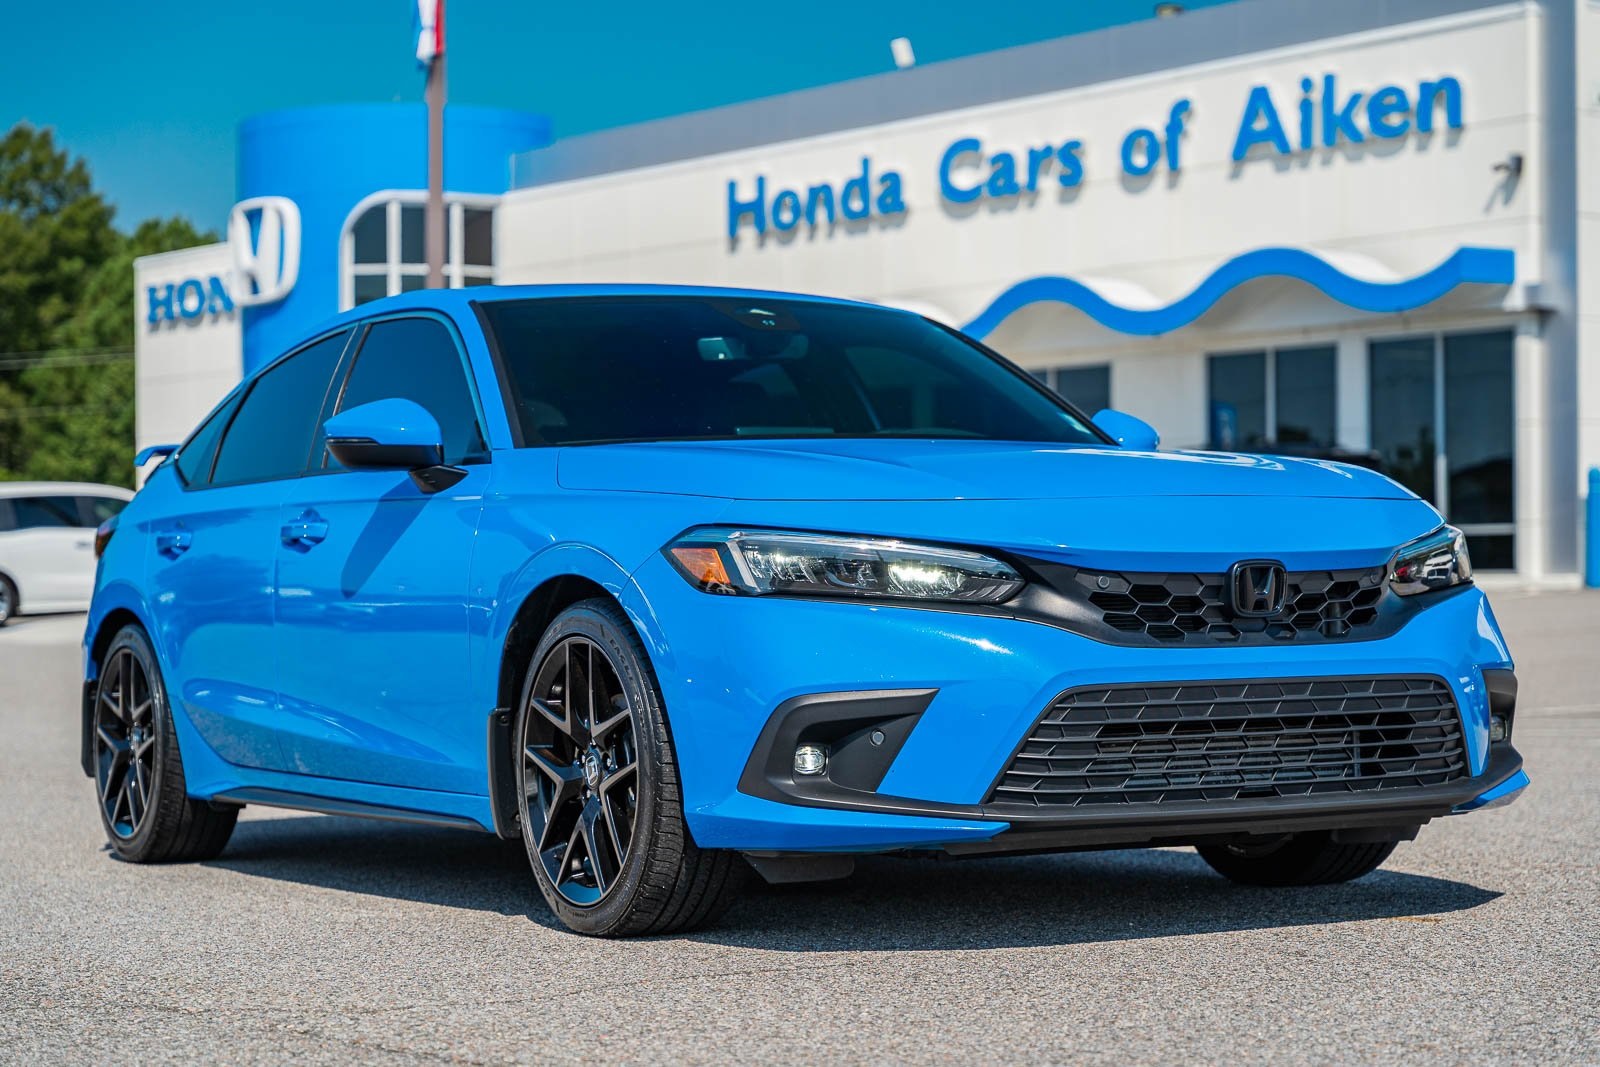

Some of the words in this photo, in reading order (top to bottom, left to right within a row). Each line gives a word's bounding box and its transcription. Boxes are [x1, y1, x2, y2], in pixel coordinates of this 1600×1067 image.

[727, 156, 906, 242] Honda
[939, 137, 1083, 205] Cars
[1120, 98, 1191, 178] of
[1231, 72, 1463, 162] Aiken
